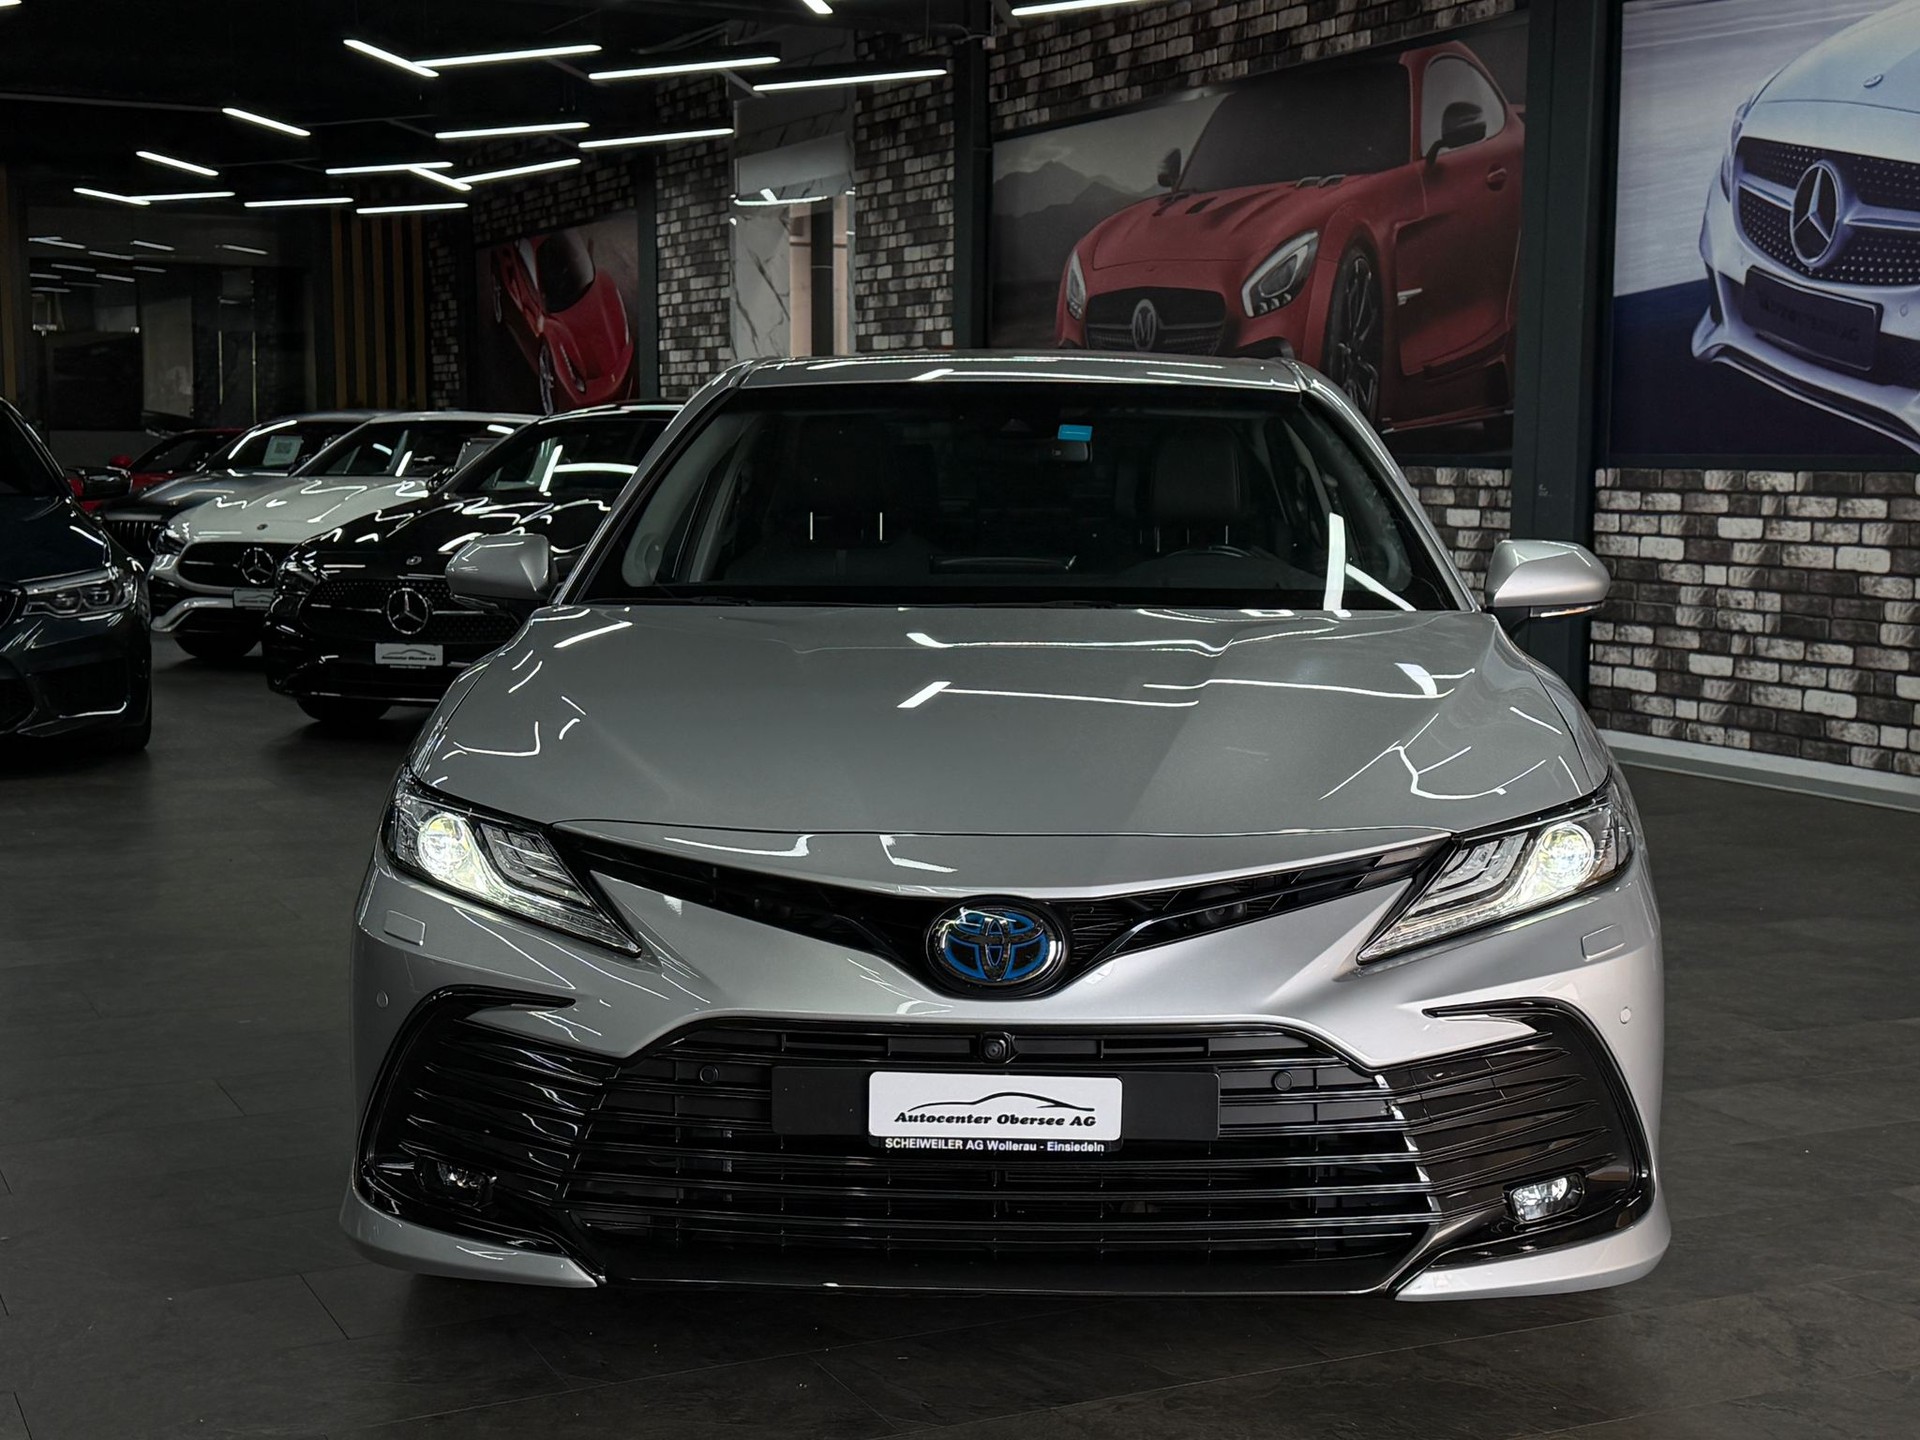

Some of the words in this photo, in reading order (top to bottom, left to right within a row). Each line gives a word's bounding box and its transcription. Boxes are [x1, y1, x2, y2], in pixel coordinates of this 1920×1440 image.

[894, 1112, 992, 1125] Autocenter
[997, 1114, 1065, 1126] Obersee
[1070, 1116, 1097, 1127] AG
[885, 1138, 963, 1150] SCHEIWEILER
[966, 1140, 984, 1151] AG
[987, 1141, 1037, 1152] Wollerau
[1047, 1142, 1105, 1153] Einsiedeln
